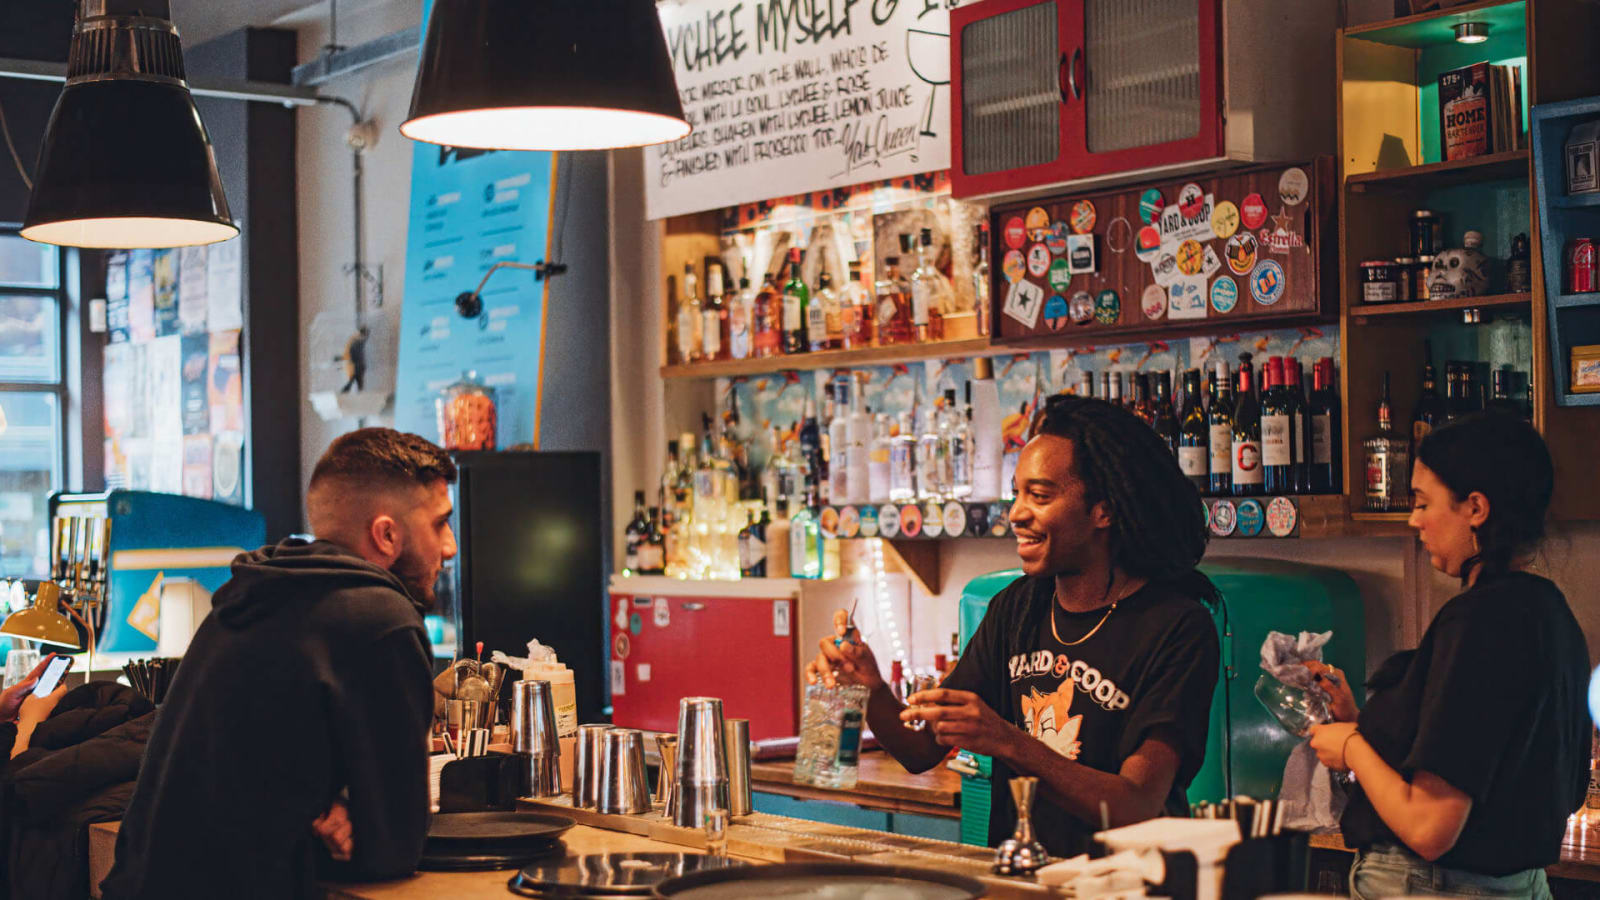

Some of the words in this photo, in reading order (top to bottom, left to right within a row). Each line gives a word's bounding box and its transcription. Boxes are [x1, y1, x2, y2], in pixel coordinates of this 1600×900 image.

[668, 3, 749, 72] YCHEE
[757, 0, 857, 54] MYSELF
[749, 70, 765, 91] ON
[769, 64, 792, 84] THE
[704, 103, 728, 122] WITH
[713, 120, 756, 145] SHAKEN
[759, 113, 785, 135] WITH
[834, 93, 872, 120] LEMON
[876, 84, 913, 111] JUICE
[1447, 107, 1484, 128] HOME
[1448, 123, 1484, 139] BARTENDER
[675, 152, 721, 178] FINISHED
[724, 144, 750, 167] WITH
[753, 133, 808, 161] PROSECCO
[1259, 228, 1303, 247] Estrella
[1008, 650, 1053, 680] YARD
[1054, 654, 1070, 675] &
[1071, 660, 1130, 710] COOP
